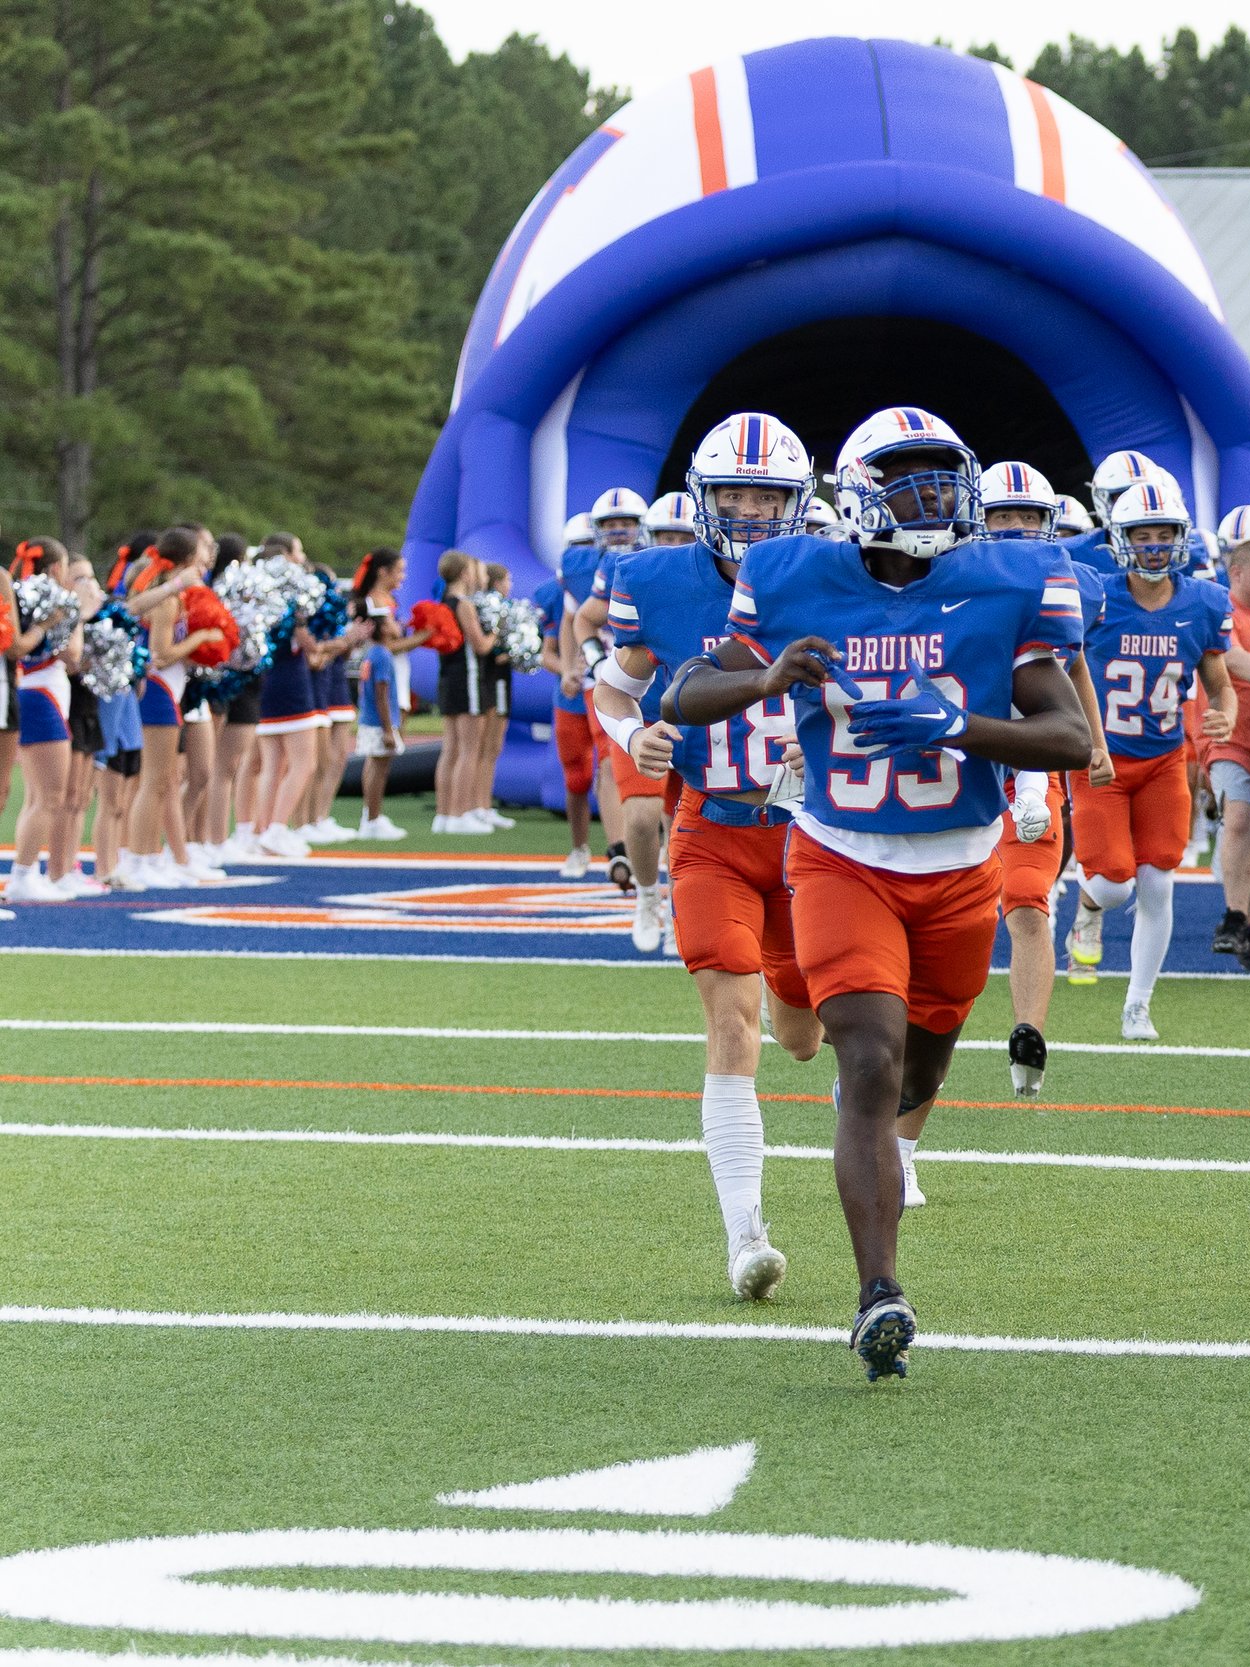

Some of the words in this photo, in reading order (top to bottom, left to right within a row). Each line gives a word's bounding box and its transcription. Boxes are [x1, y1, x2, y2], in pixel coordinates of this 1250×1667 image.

[735, 467, 769, 476] Riddell
[846, 634, 944, 671] BRUINS
[1120, 634, 1178, 657] BRUINS
[1104, 659, 1183, 736] 24
